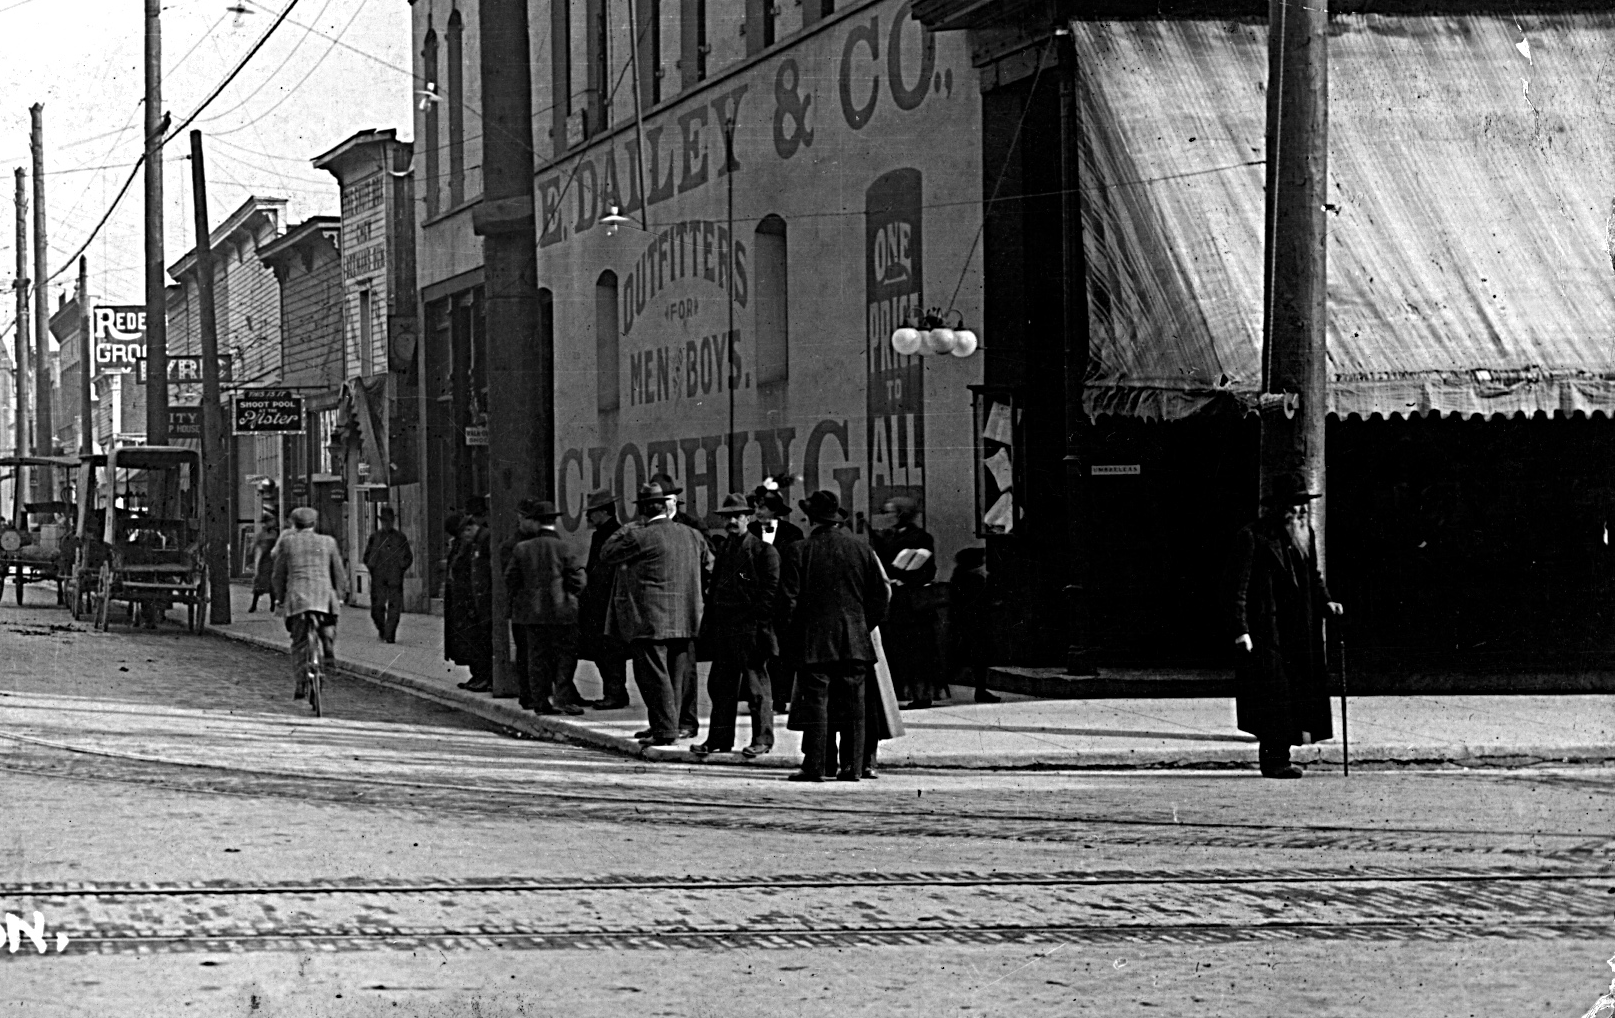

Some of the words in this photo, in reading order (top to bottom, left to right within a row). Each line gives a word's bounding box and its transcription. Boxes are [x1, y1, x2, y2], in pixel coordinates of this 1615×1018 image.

[575, 84, 749, 234] DAILEY
[774, 59, 814, 160] &
[624, 219, 748, 335] OUTFITTERS
[874, 222, 912, 283] ONE
[670, 297, 693, 322] FOR
[869, 293, 920, 373] PRICE
[631, 346, 669, 406] MEN
[687, 329, 750, 398] BOYS.
[886, 378, 902, 400] TO
[558, 419, 861, 533] CLOTHING
[871, 413, 923, 488] ALL
